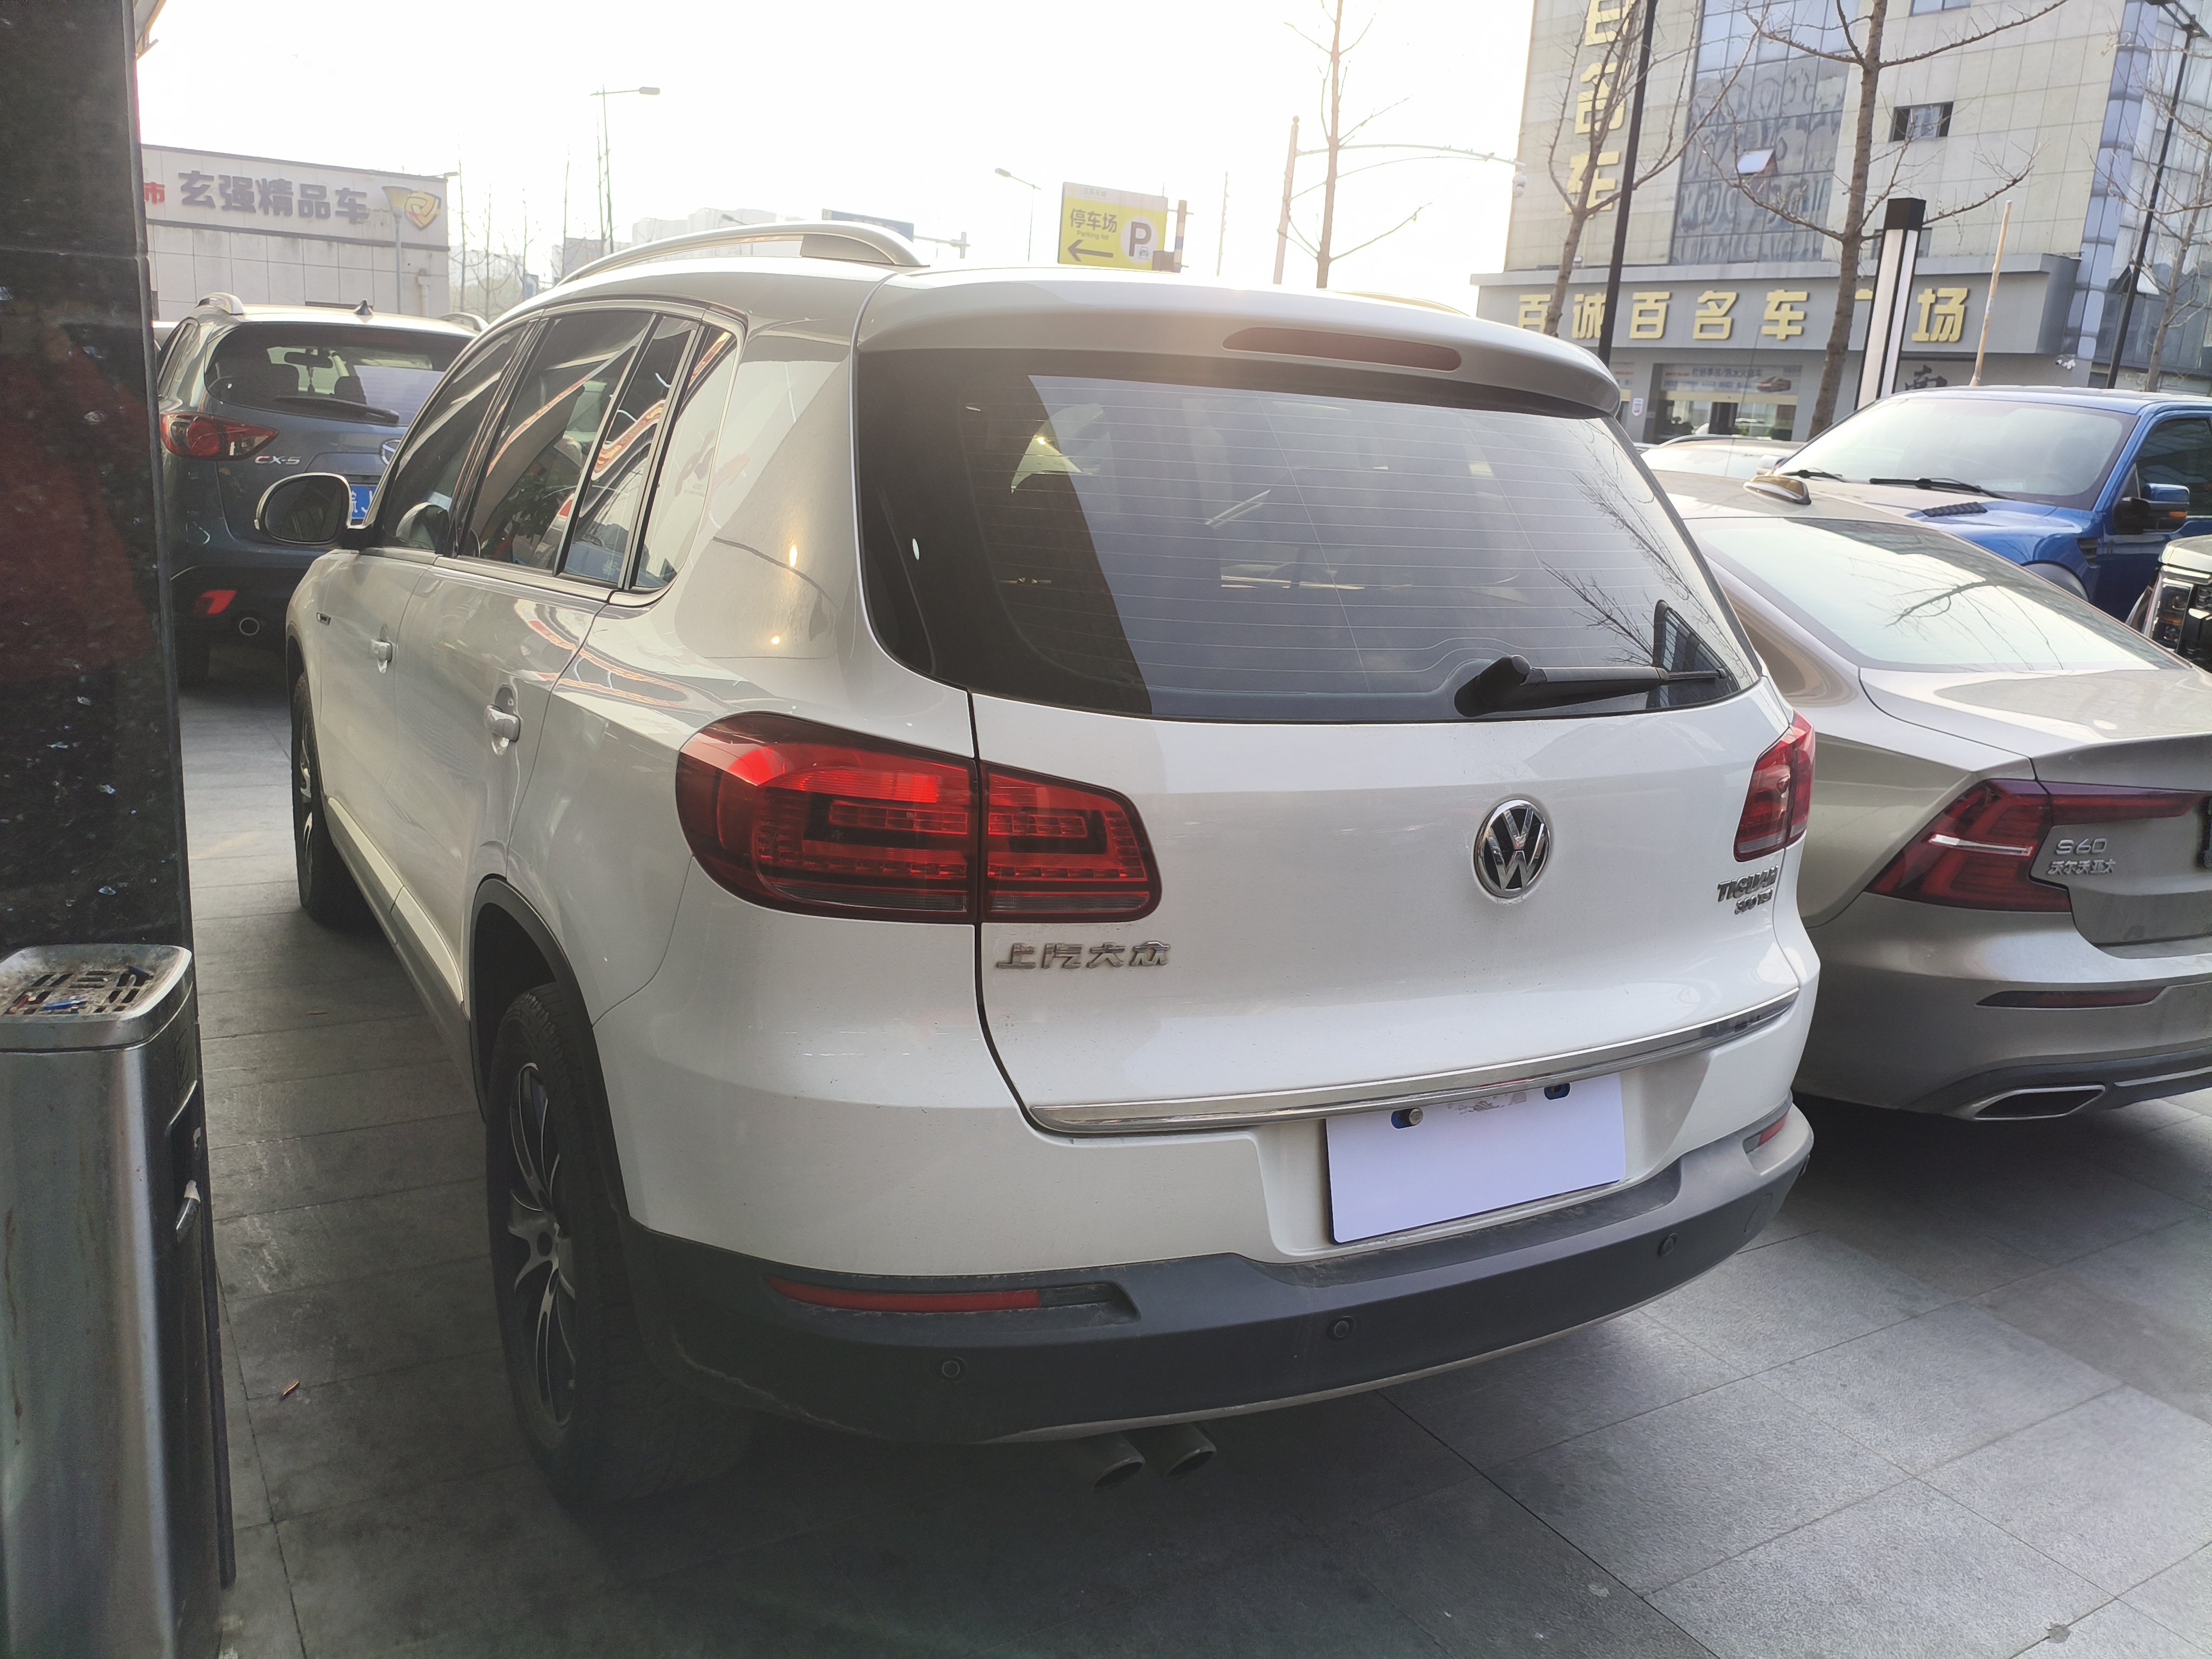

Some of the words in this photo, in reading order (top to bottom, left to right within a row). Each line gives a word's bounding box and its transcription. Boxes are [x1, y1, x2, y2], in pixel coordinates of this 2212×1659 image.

[178, 170, 369, 224] 玄强精品车
[1070, 208, 1117, 233] 停车场
[1129, 221, 1152, 257] P
[1518, 287, 1969, 342] 百诚百名车场
[255, 455, 302, 464] CX-5
[2055, 838, 2107, 855] S60
[2047, 858, 2116, 875] 沃尔沃亚太
[996, 941, 1170, 969] 上汽大众
